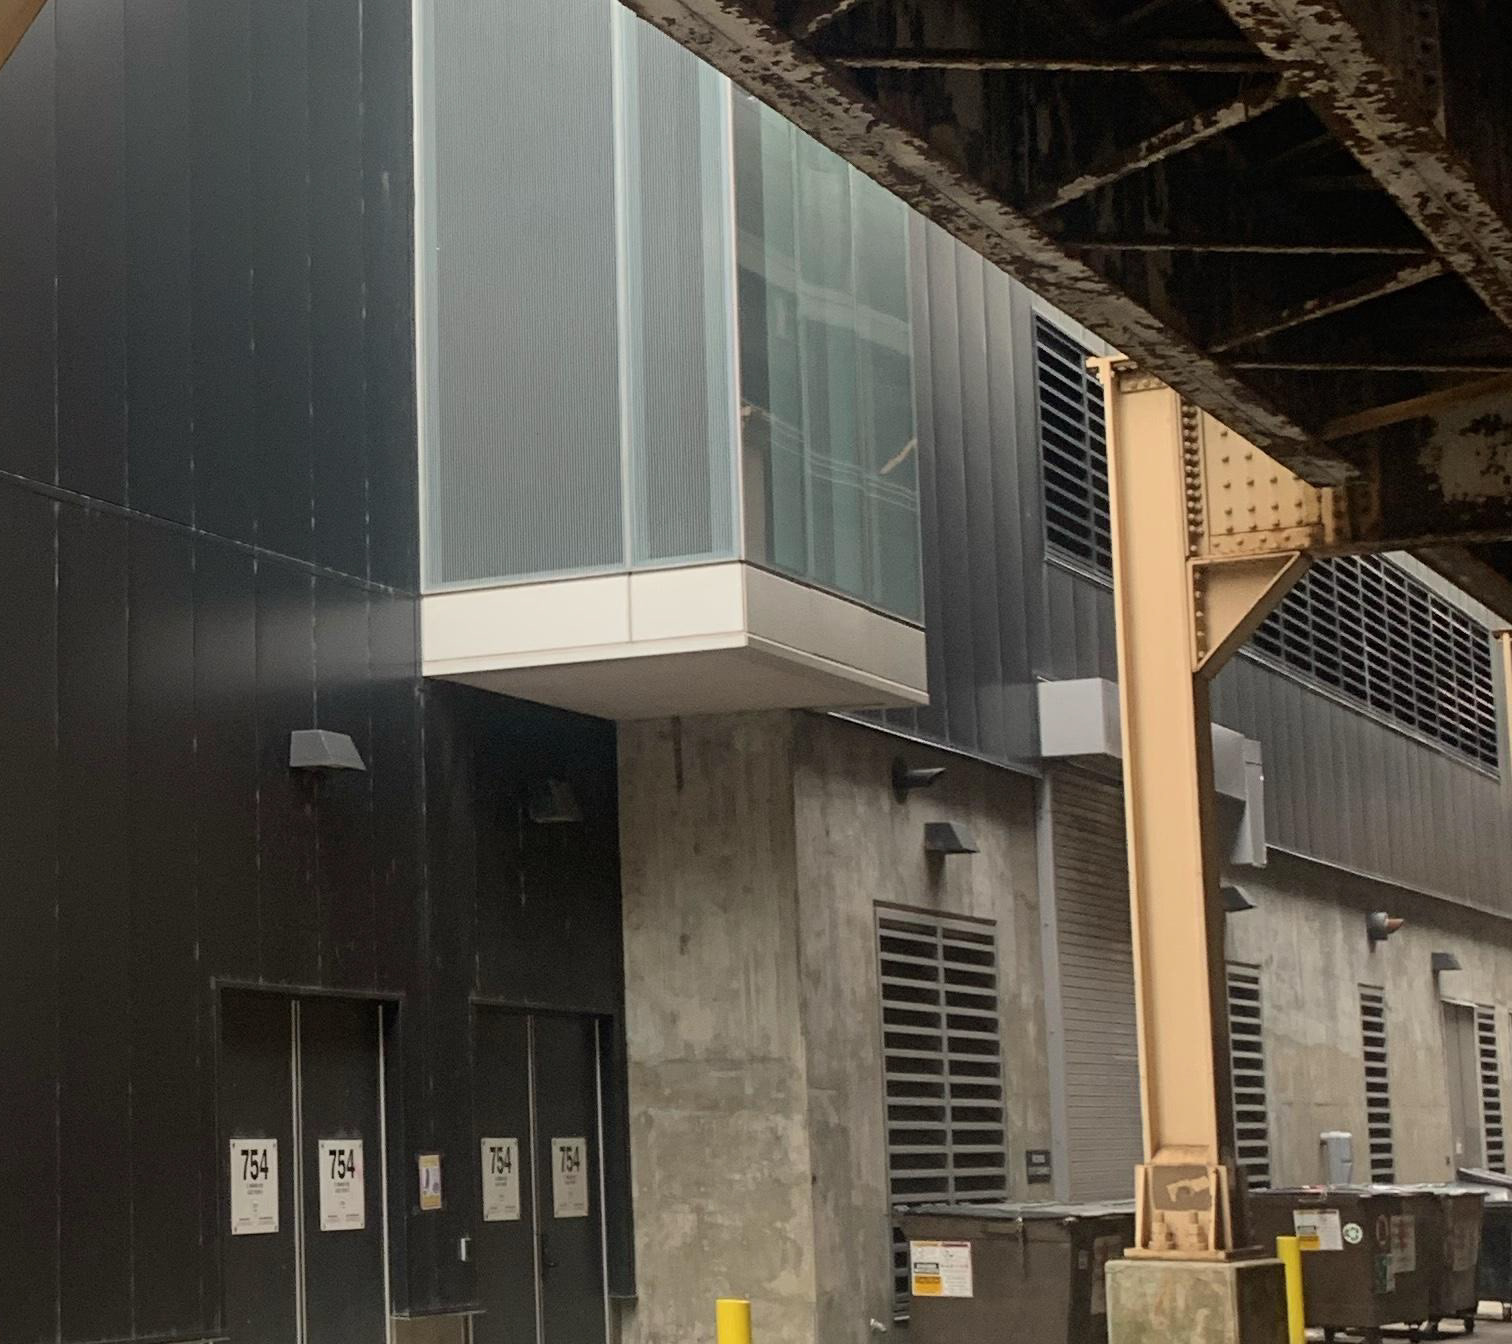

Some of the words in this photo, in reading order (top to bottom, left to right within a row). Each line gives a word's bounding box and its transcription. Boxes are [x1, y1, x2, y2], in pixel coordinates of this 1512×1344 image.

[241, 1149, 269, 1181] 754
[329, 1149, 355, 1179] 754
[490, 1146, 512, 1174] 754
[559, 1146, 580, 1173] 754
